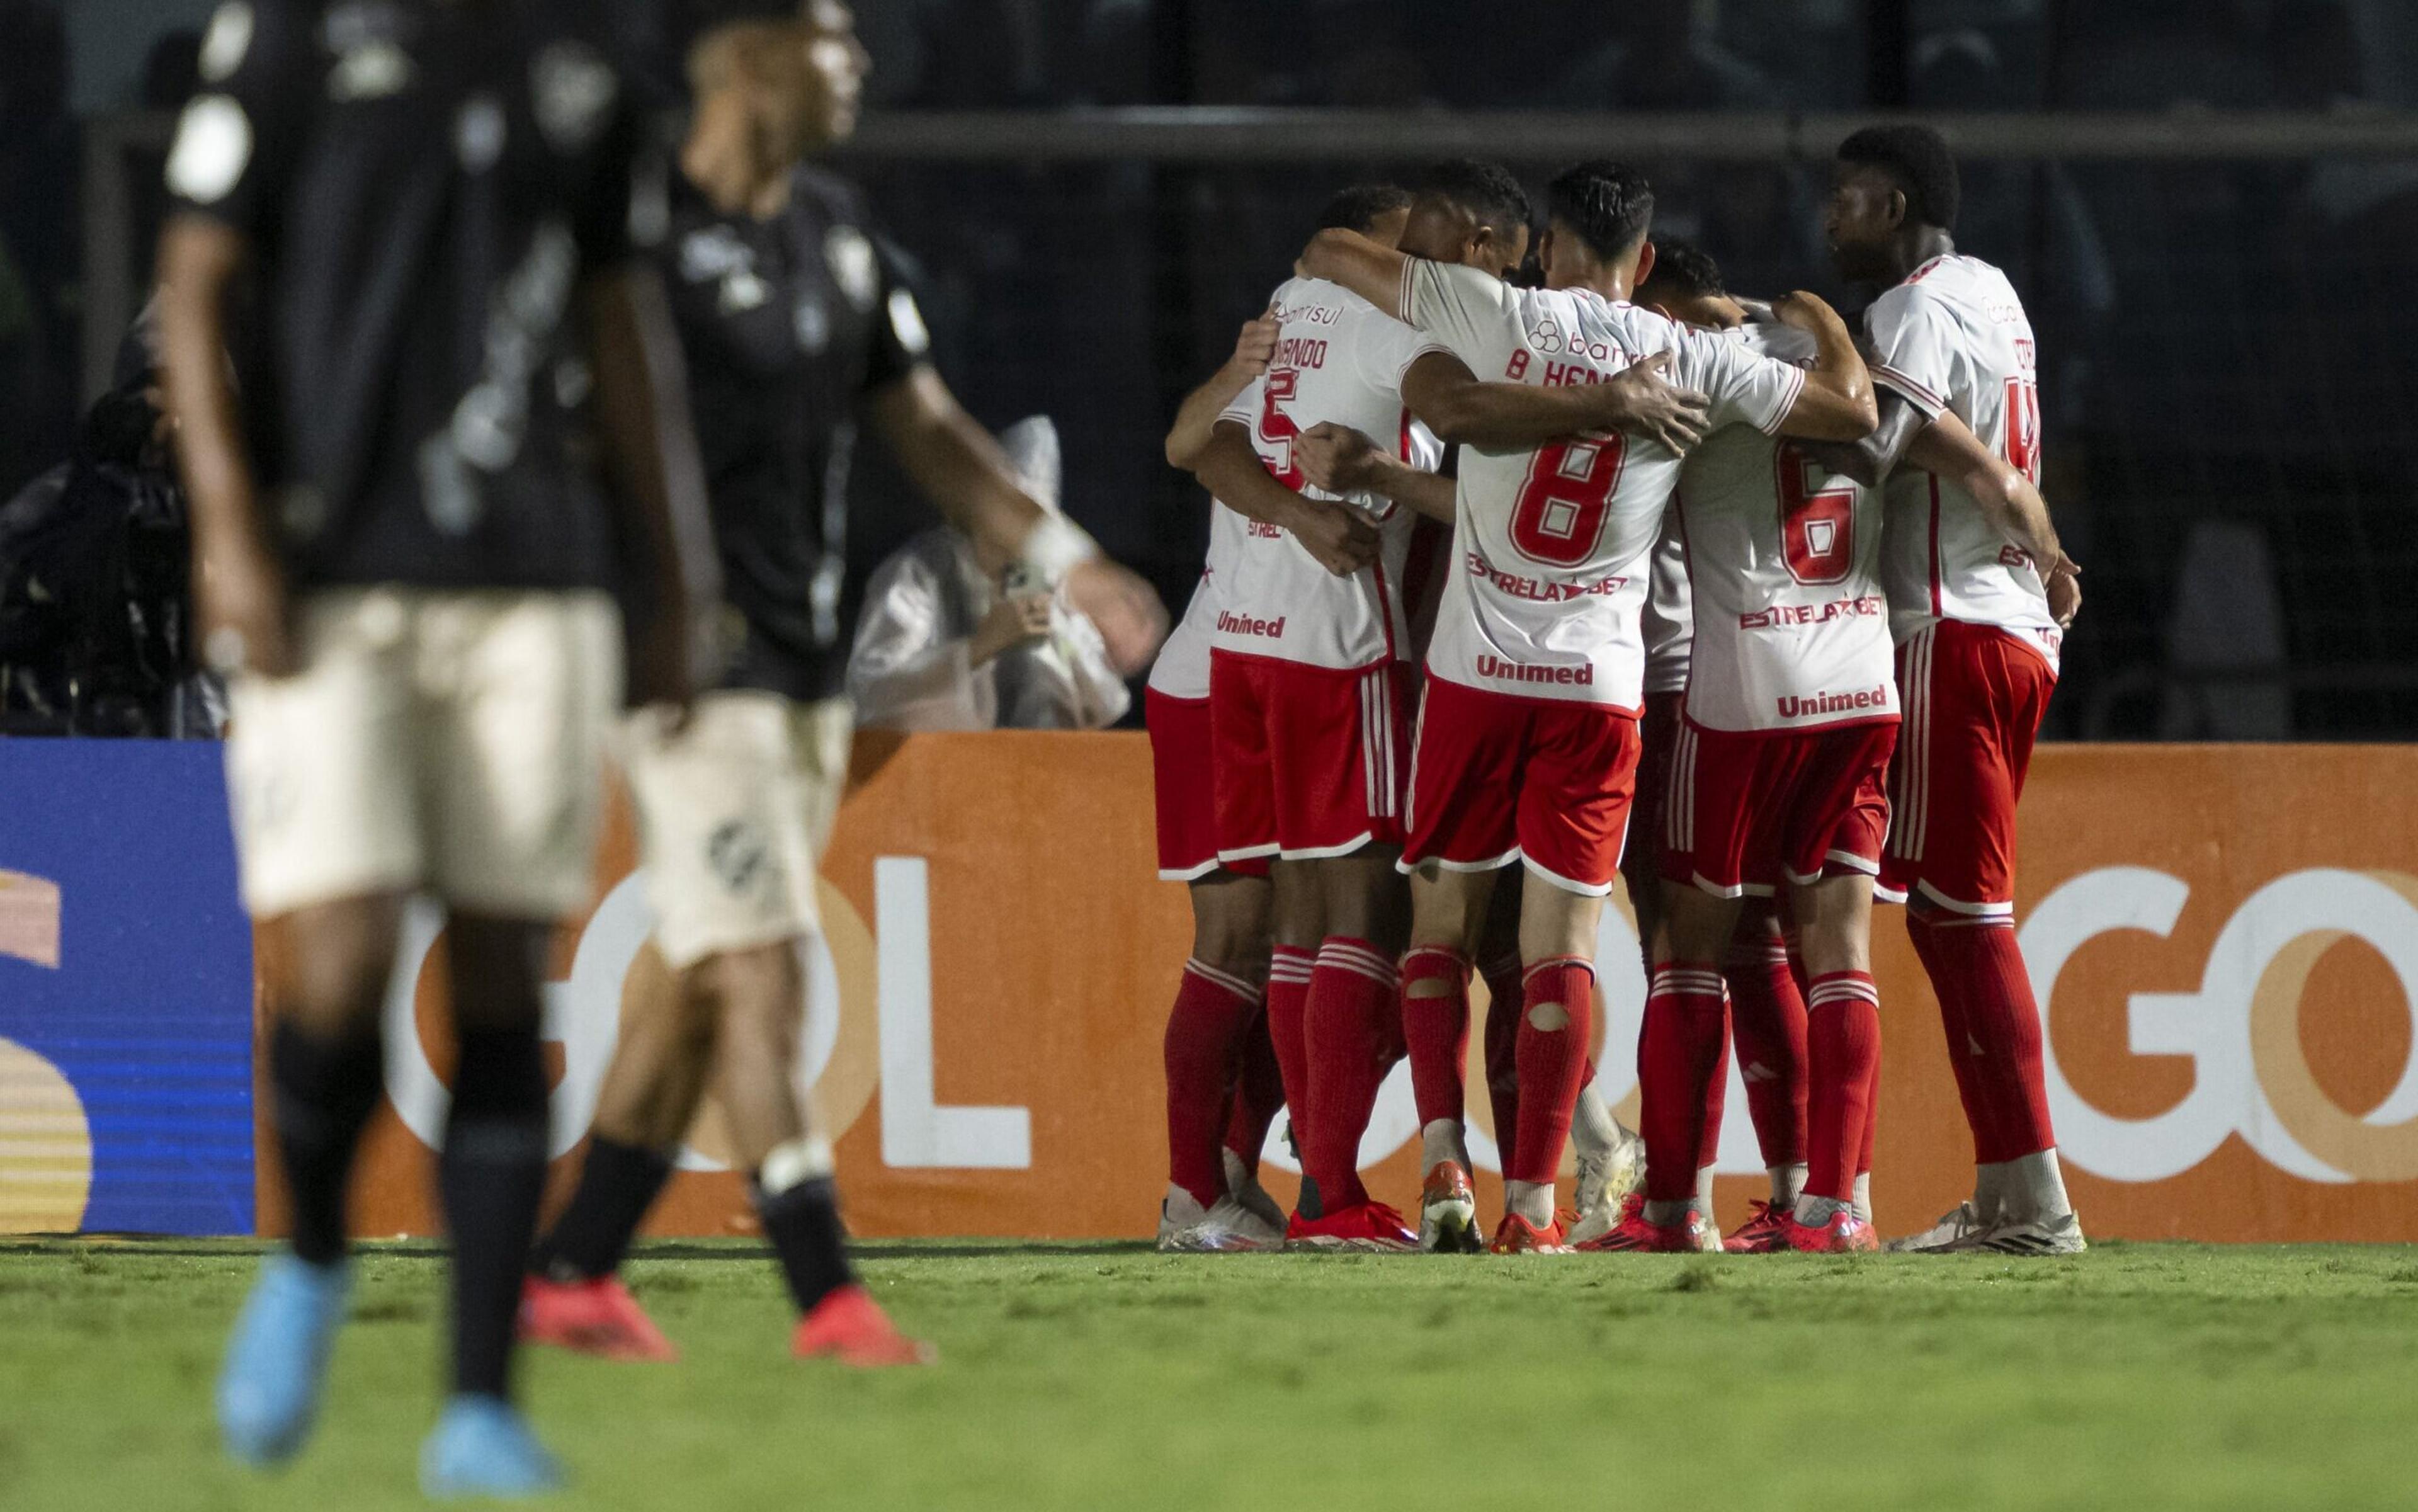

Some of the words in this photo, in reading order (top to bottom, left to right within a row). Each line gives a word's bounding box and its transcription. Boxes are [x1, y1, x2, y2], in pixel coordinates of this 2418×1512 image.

[1259, 367, 1305, 494] 5
[1509, 428, 1628, 569] 8
[1773, 438, 1856, 586] 6
[1217, 610, 1286, 639] Unimed
[1477, 655, 1594, 685] Unimed
[1778, 684, 1887, 719] Unimed
